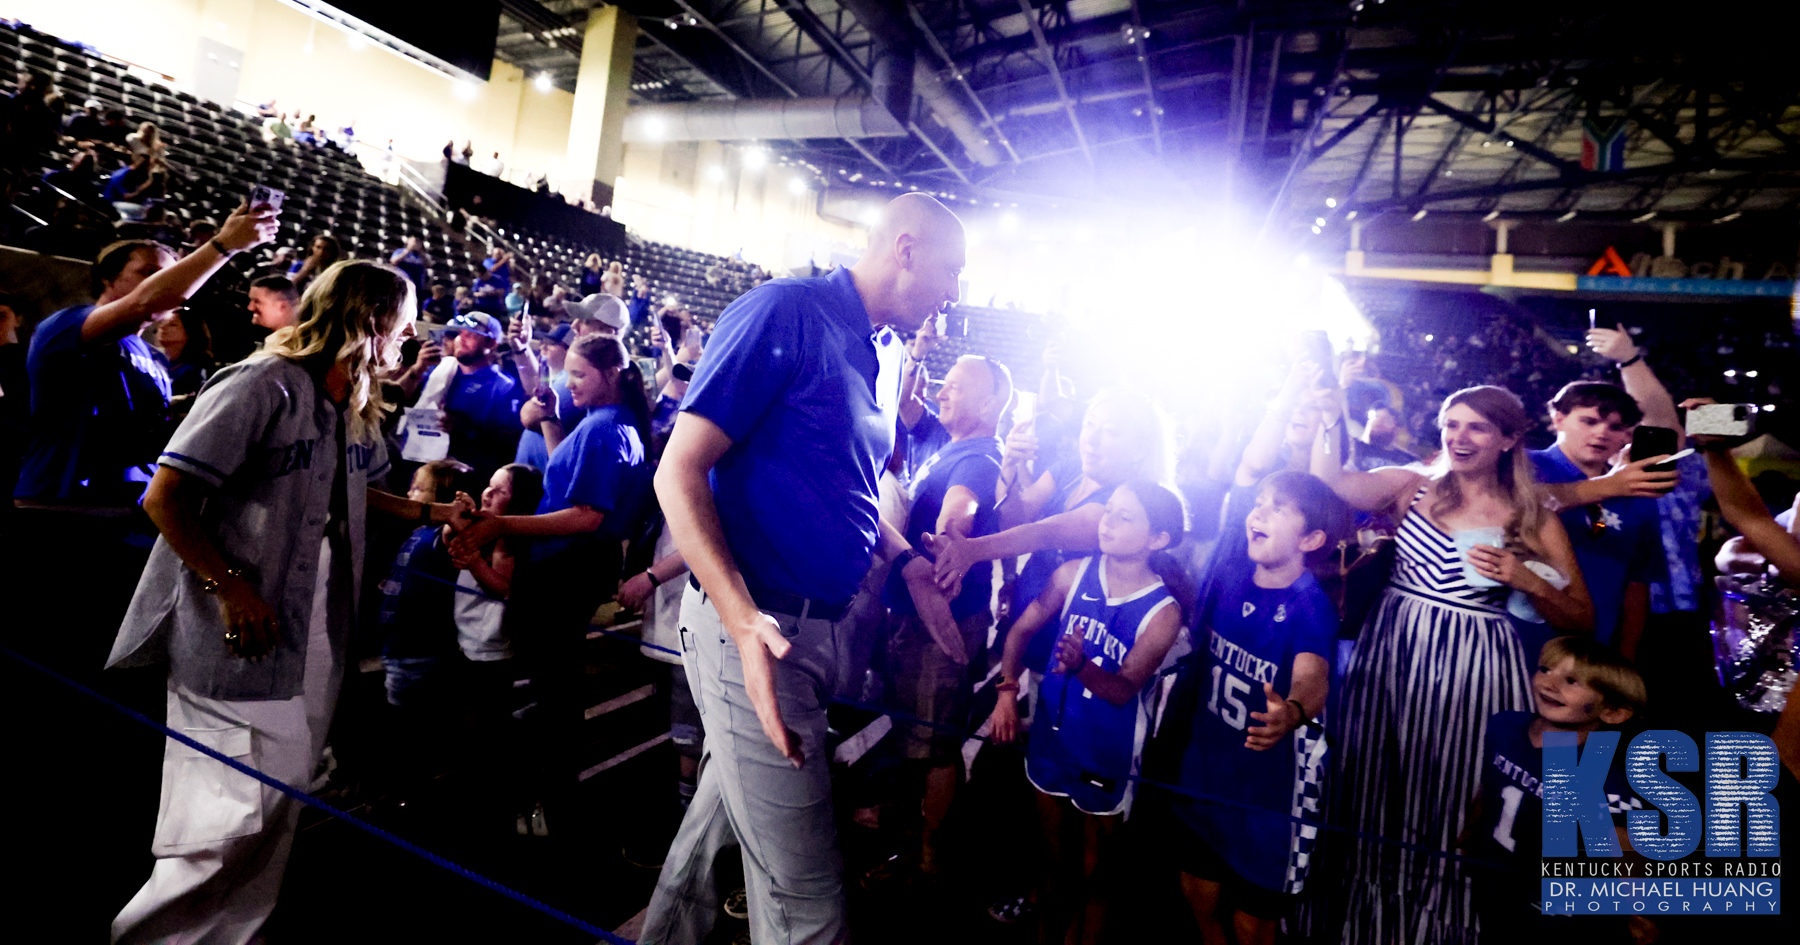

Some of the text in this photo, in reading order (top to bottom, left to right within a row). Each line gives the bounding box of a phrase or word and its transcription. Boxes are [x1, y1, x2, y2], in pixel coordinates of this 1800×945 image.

[1065, 614, 1127, 667] KENTCKY
[1208, 629, 1279, 686] ENTUCKY
[1207, 664, 1251, 731] 15
[1493, 785, 1524, 853] 1
